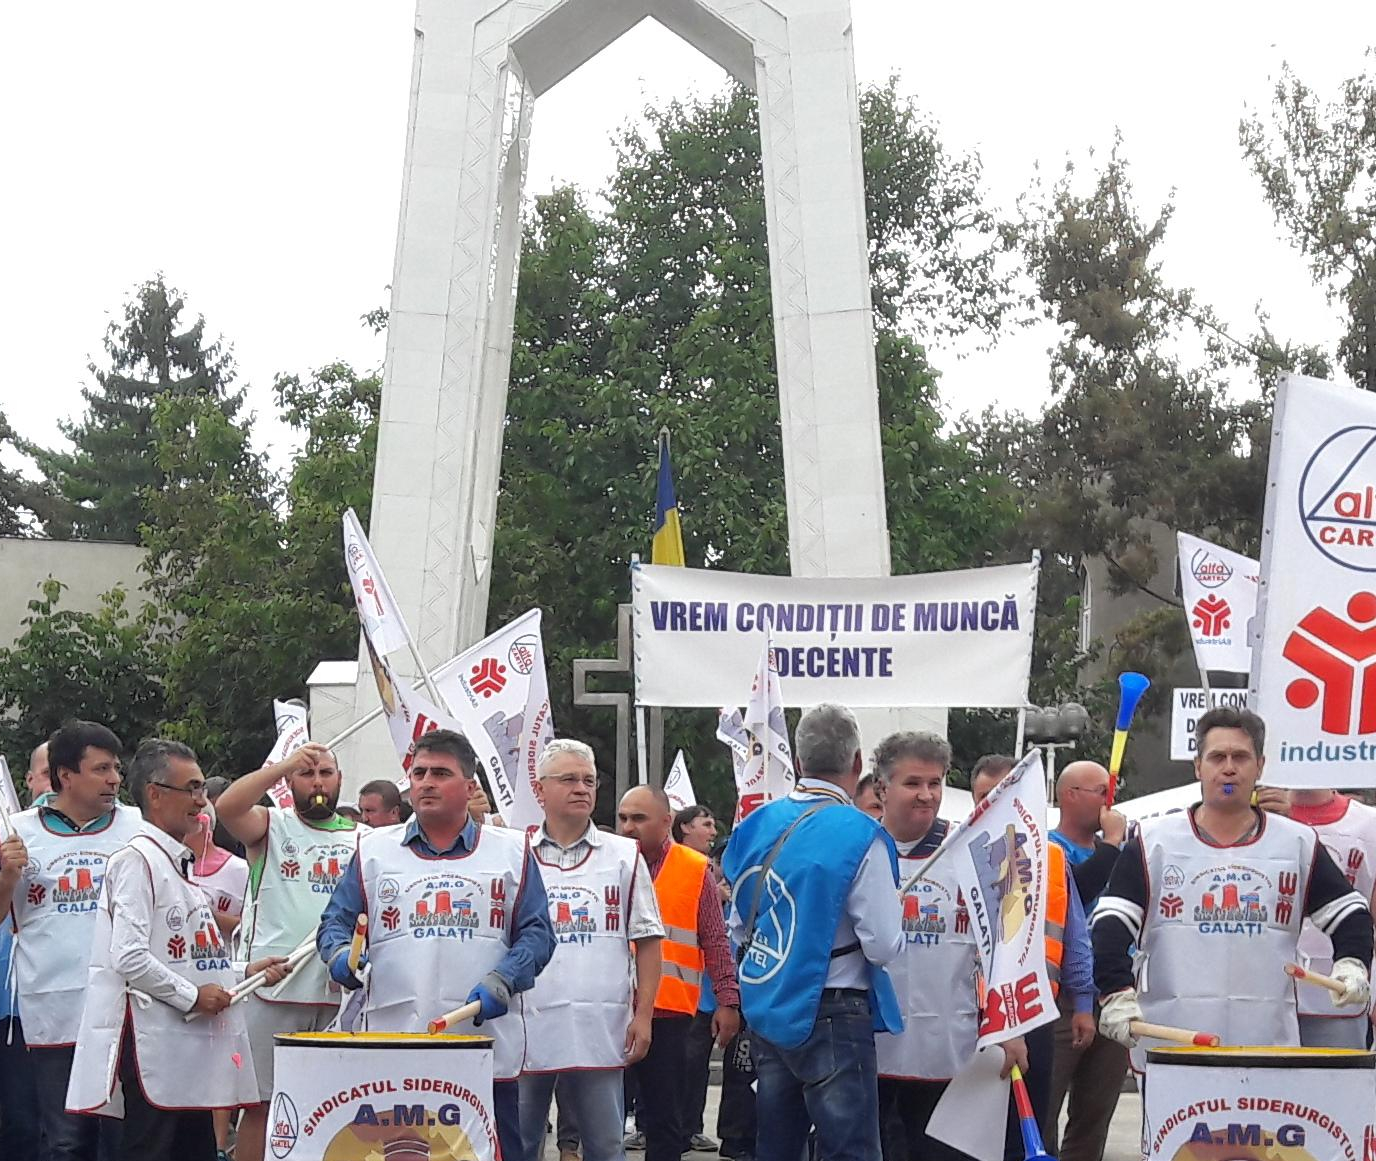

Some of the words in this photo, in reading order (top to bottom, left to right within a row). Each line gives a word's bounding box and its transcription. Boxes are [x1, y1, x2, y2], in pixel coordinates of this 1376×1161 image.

[651, 601, 728, 632] VREM
[736, 601, 863, 641] CONDIȚII
[871, 603, 906, 632] DE
[914, 593, 1020, 632] MUNCĂ
[774, 646, 893, 678] DECENTE
[57, 902, 98, 913] GALA
[304, 1079, 397, 1136] SINDICATUL
[352, 1103, 461, 1127] A.M.G
[1153, 1098, 1232, 1152] SINDICATUL
[1189, 1122, 1306, 1147] A.M.G
